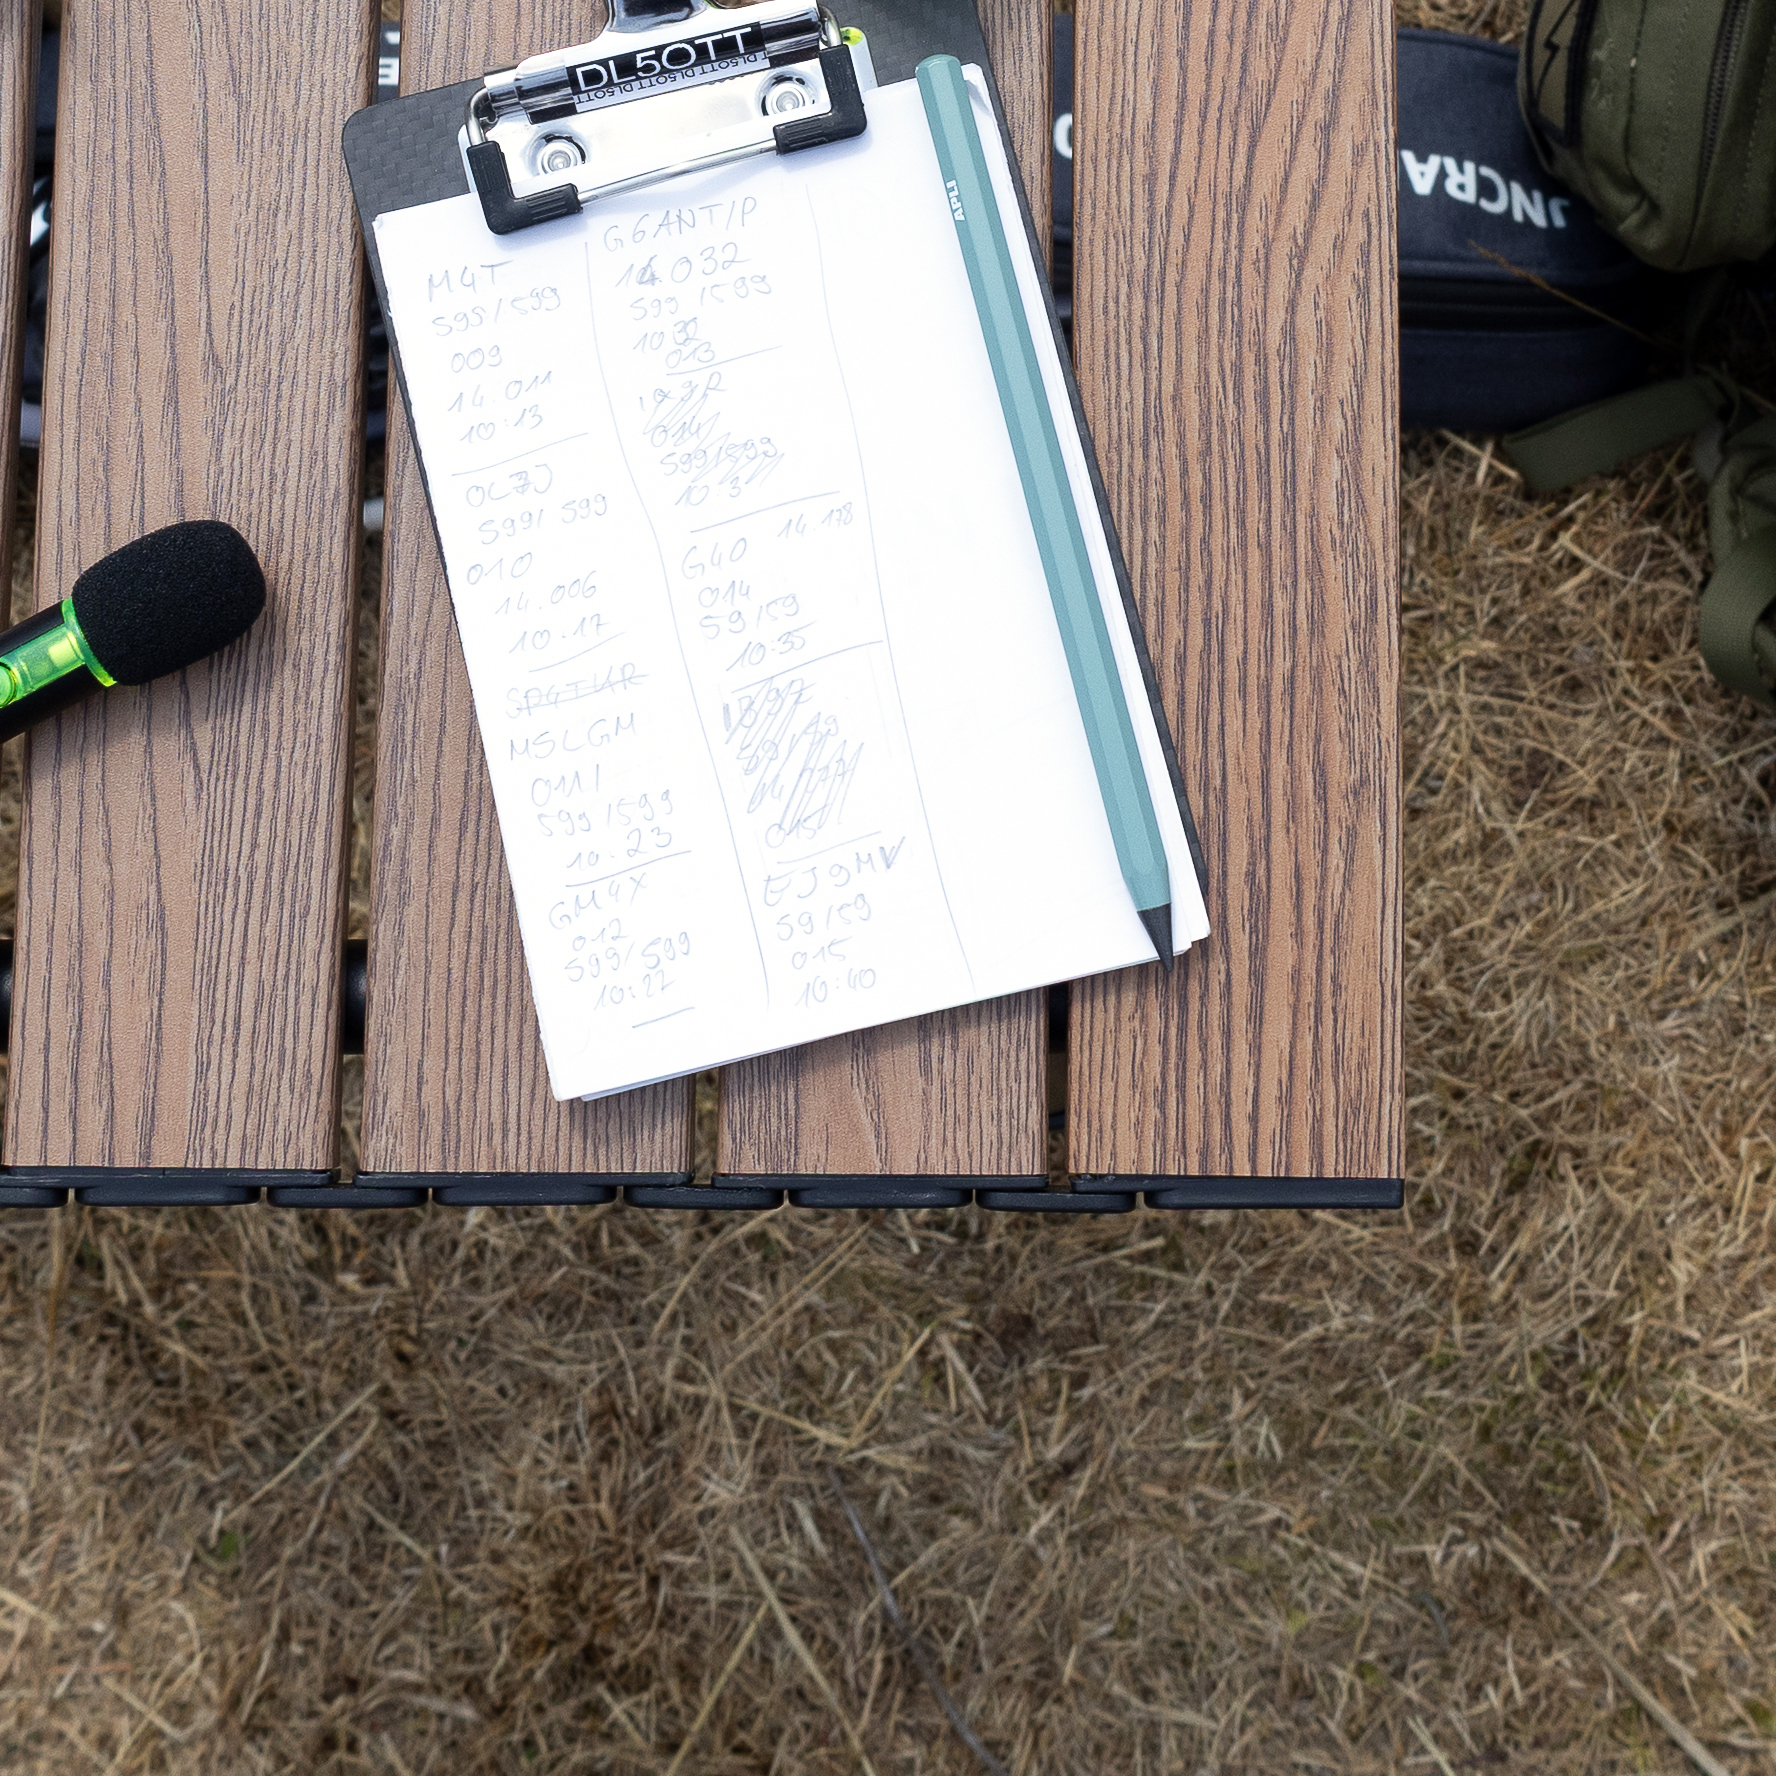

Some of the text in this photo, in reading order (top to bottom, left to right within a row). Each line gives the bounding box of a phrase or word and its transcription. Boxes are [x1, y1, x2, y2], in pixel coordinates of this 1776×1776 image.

[574, 26, 753, 94] DL5OTT
[943, 178, 968, 223] APLI
[427, 259, 515, 303] M4T
[450, 344, 503, 374] 009
[665, 341, 716, 369] 013
[466, 551, 533, 586] 010
[572, 917, 631, 952] 012
[791, 935, 854, 971] 015
